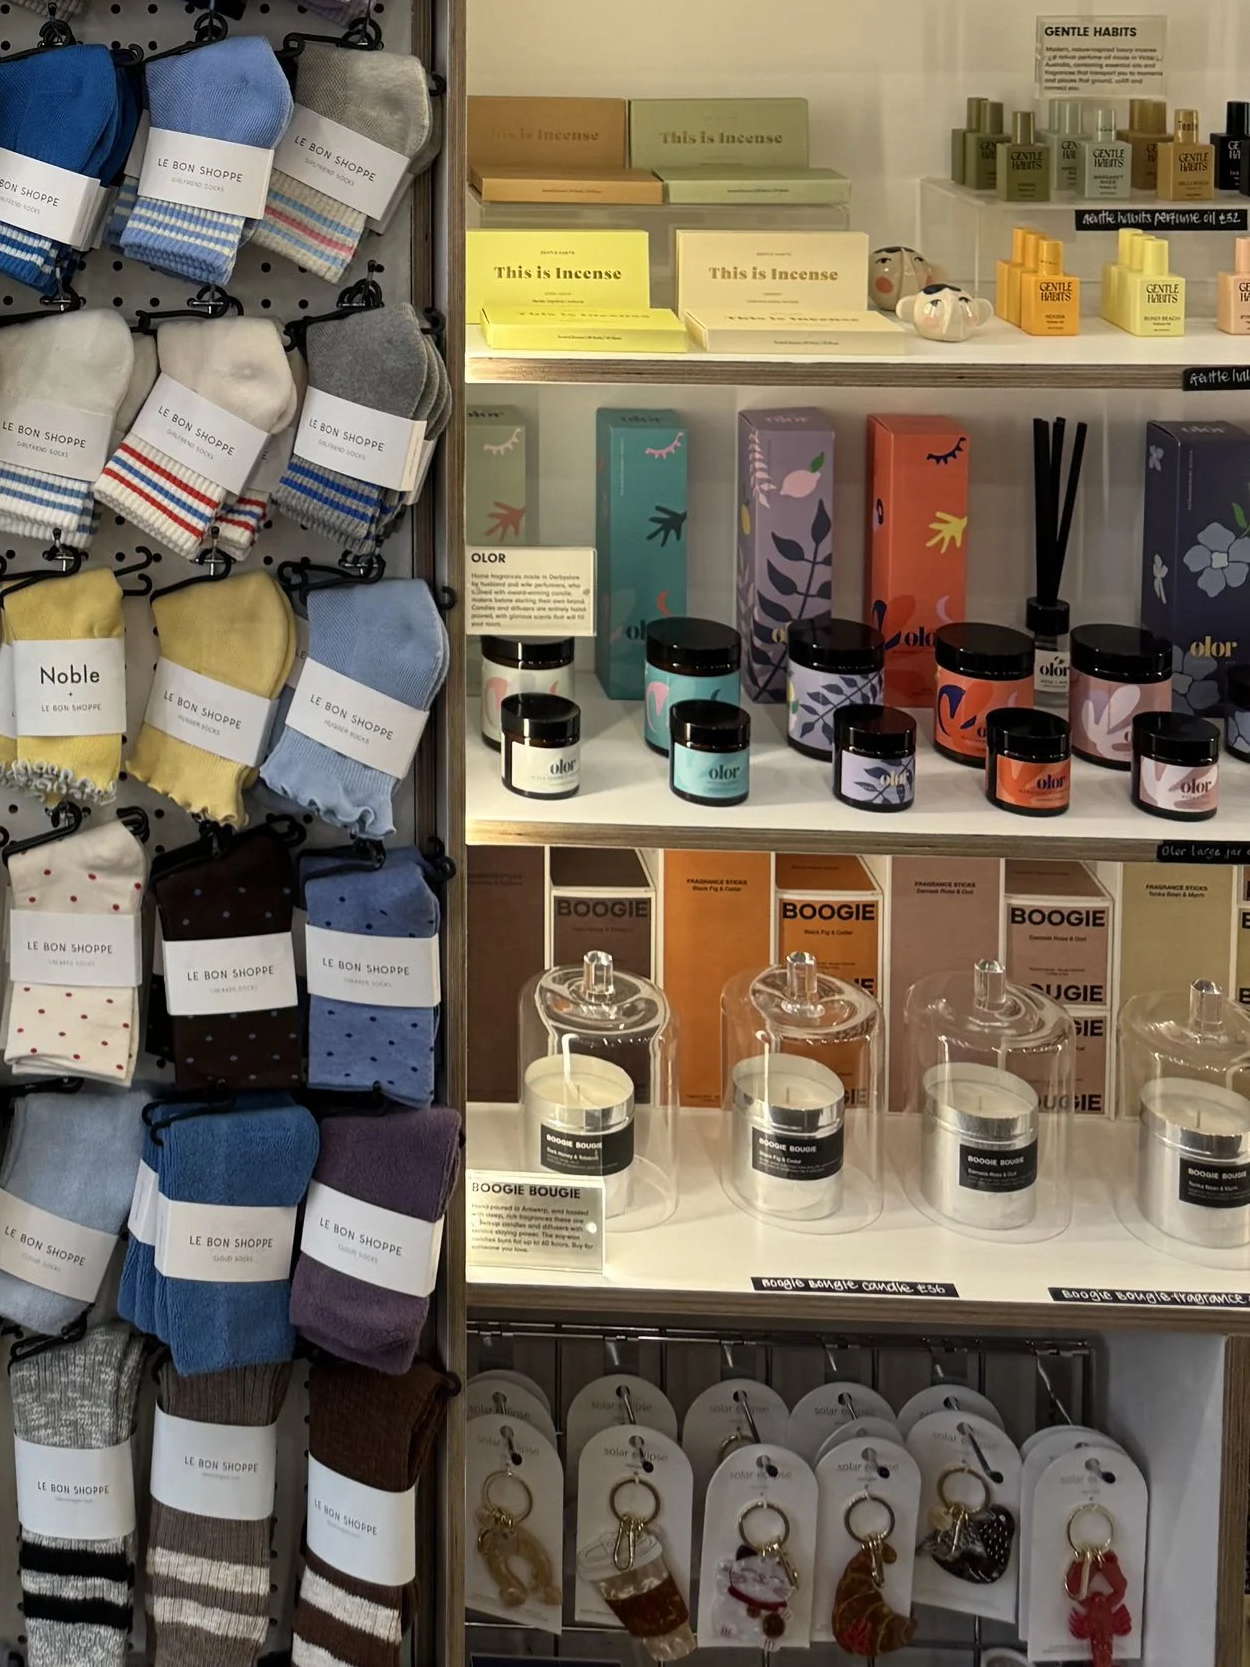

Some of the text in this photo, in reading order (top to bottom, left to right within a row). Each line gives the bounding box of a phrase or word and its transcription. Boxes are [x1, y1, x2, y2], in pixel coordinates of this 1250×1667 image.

[1044, 26, 1137, 37] GENTLE HABITS
[660, 131, 782, 145] This is Incense
[1010, 151, 1043, 162] GENTLE
[158, 159, 242, 182] LE BON SHOPPE
[1012, 160, 1042, 171] HABITS
[494, 266, 622, 281] This is Incense
[709, 267, 839, 282] This is Incense
[1039, 281, 1073, 293] GENTLE
[1146, 283, 1179, 294] GENTLE
[1040, 291, 1071, 302] HABITS
[1146, 292, 1178, 304] HABITS
[3, 422, 86, 448] LE BON SHOPPE
[471, 553, 506, 563] OLOR
[1190, 635, 1238, 658] olor
[40, 664, 100, 684] Noble
[1039, 661, 1070, 677] olor
[550, 758, 577, 775] olor
[709, 765, 740, 780] olor
[1036, 773, 1066, 790] olor
[1180, 777, 1212, 794] olor
[1162, 845, 1242, 860] Olor large jar
[557, 899, 648, 918] BOOGIE
[782, 902, 875, 920] BOOGIE
[1010, 907, 1105, 927] BOOGIE
[759, 1138, 816, 1153] BOOGIE BOUGIE
[968, 1155, 1024, 1166] BOOGIE BOUGIE
[472, 1183, 580, 1199] BOOGIE BOUGIE
[190, 1236, 272, 1247] LE BON SHOPPE
